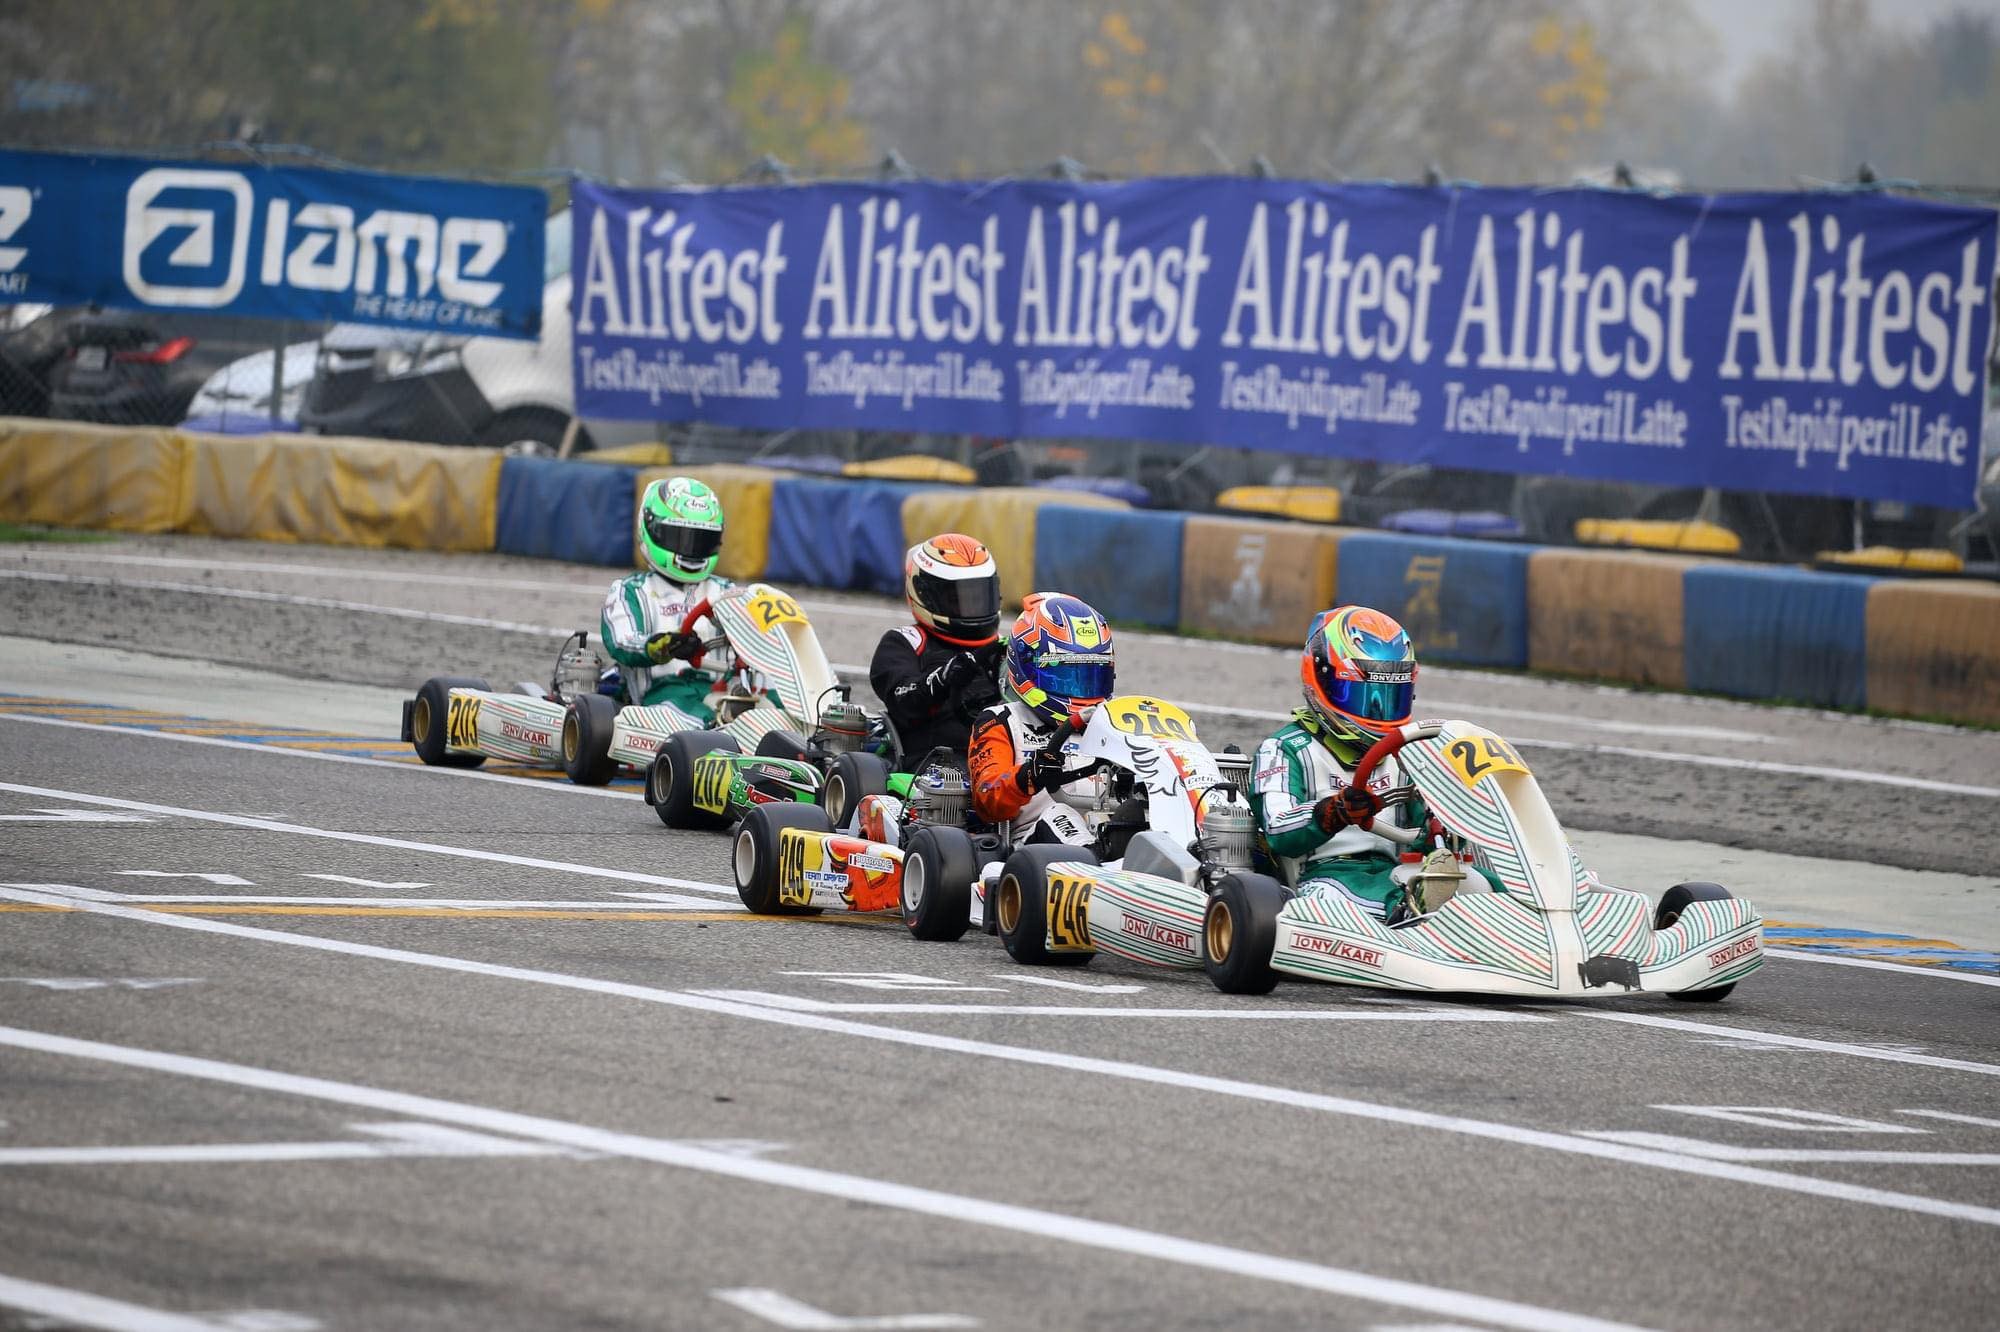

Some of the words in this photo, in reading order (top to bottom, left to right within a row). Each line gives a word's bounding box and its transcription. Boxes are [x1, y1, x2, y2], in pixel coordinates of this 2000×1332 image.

[577, 207, 788, 343] Alitest
[802, 197, 1004, 345] Alitest
[1013, 199, 1211, 350] Alitest
[1221, 197, 1442, 364] Alitest
[436, 302, 462, 325] OF
[1445, 208, 1697, 382] Alitest
[1718, 211, 1985, 396] Alitest
[758, 599, 800, 624] 20
[1368, 672, 1391, 681] TONY
[450, 697, 481, 747] 203
[502, 721, 521, 738] TONY
[522, 729, 551, 746] KART
[1023, 731, 1051, 743] KART
[629, 735, 657, 751] TONY
[1451, 737, 1527, 778] 24
[694, 759, 728, 807] 202
[780, 834, 806, 897] 249
[805, 871, 822, 880] TEAM
[824, 873, 848, 883] DRIVER
[1050, 879, 1093, 946] 246
[1122, 913, 1150, 937] TONY
[1153, 925, 1194, 949] KART
[1292, 932, 1334, 953] TONY
[1340, 943, 1385, 964] KART
[1710, 946, 1734, 968] TONY
[1735, 935, 1757, 956] KART
